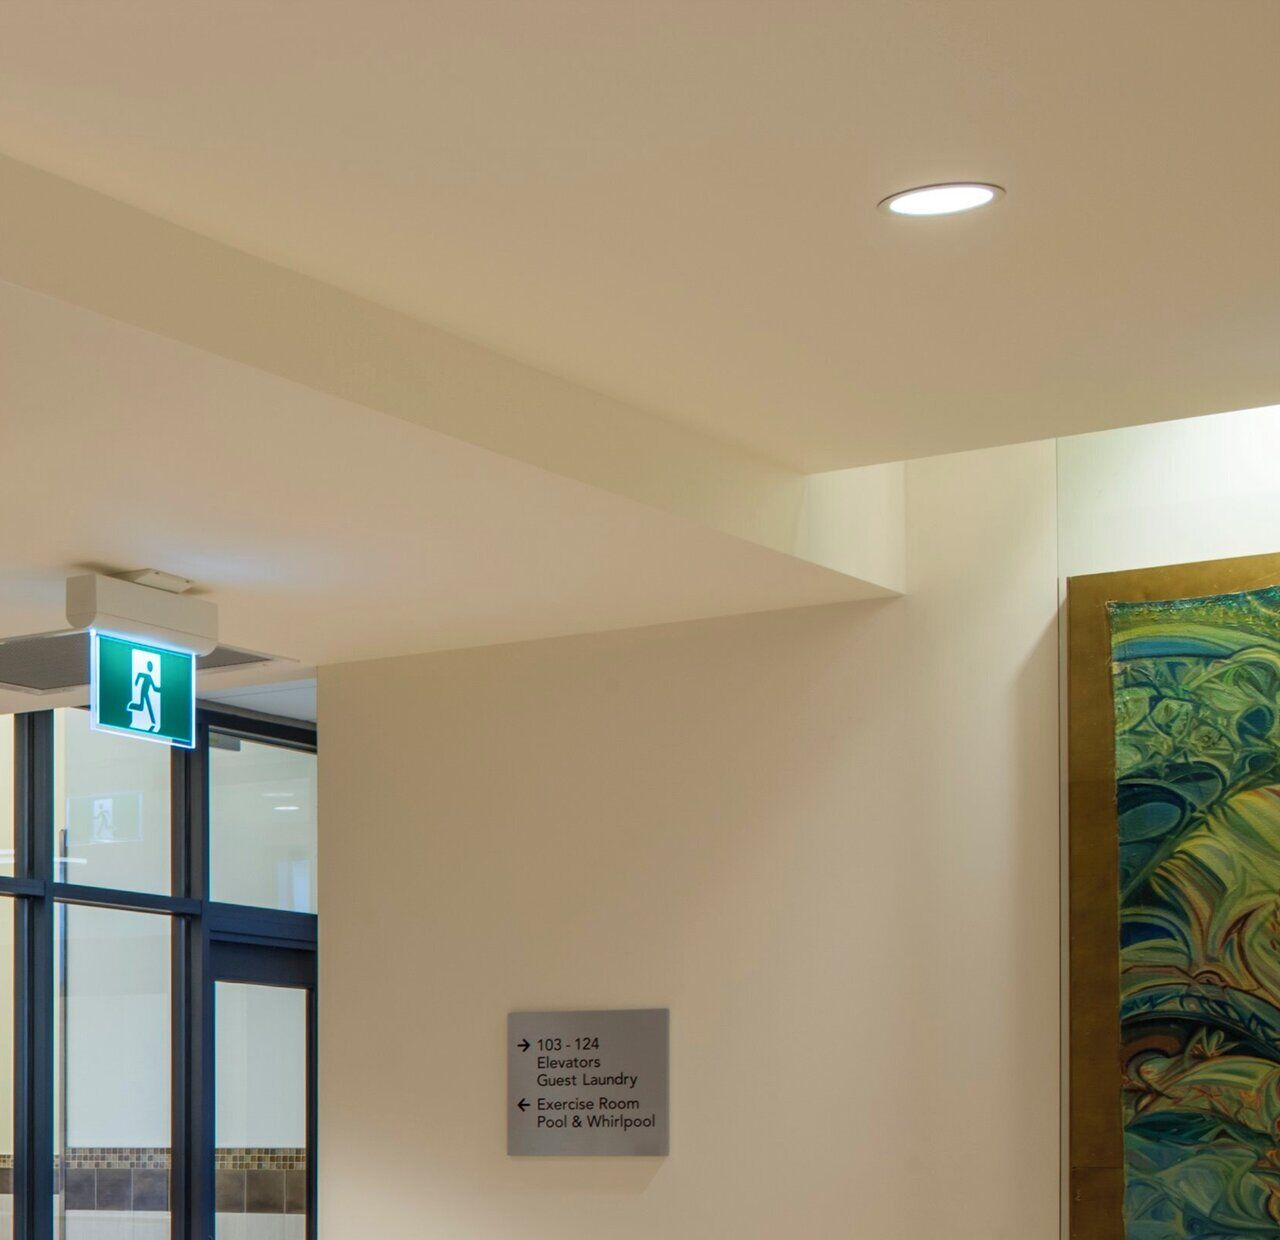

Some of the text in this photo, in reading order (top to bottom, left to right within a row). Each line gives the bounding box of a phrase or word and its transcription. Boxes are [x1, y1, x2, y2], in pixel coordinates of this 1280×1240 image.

[537, 1038, 562, 1051] 103
[575, 1037, 600, 1050] 124
[537, 1056, 601, 1069] Elevators
[537, 1072, 638, 1089] Guest Laundry
[537, 1097, 640, 1111] Exercise Room
[537, 1114, 656, 1132] Pool & Whirlpool
